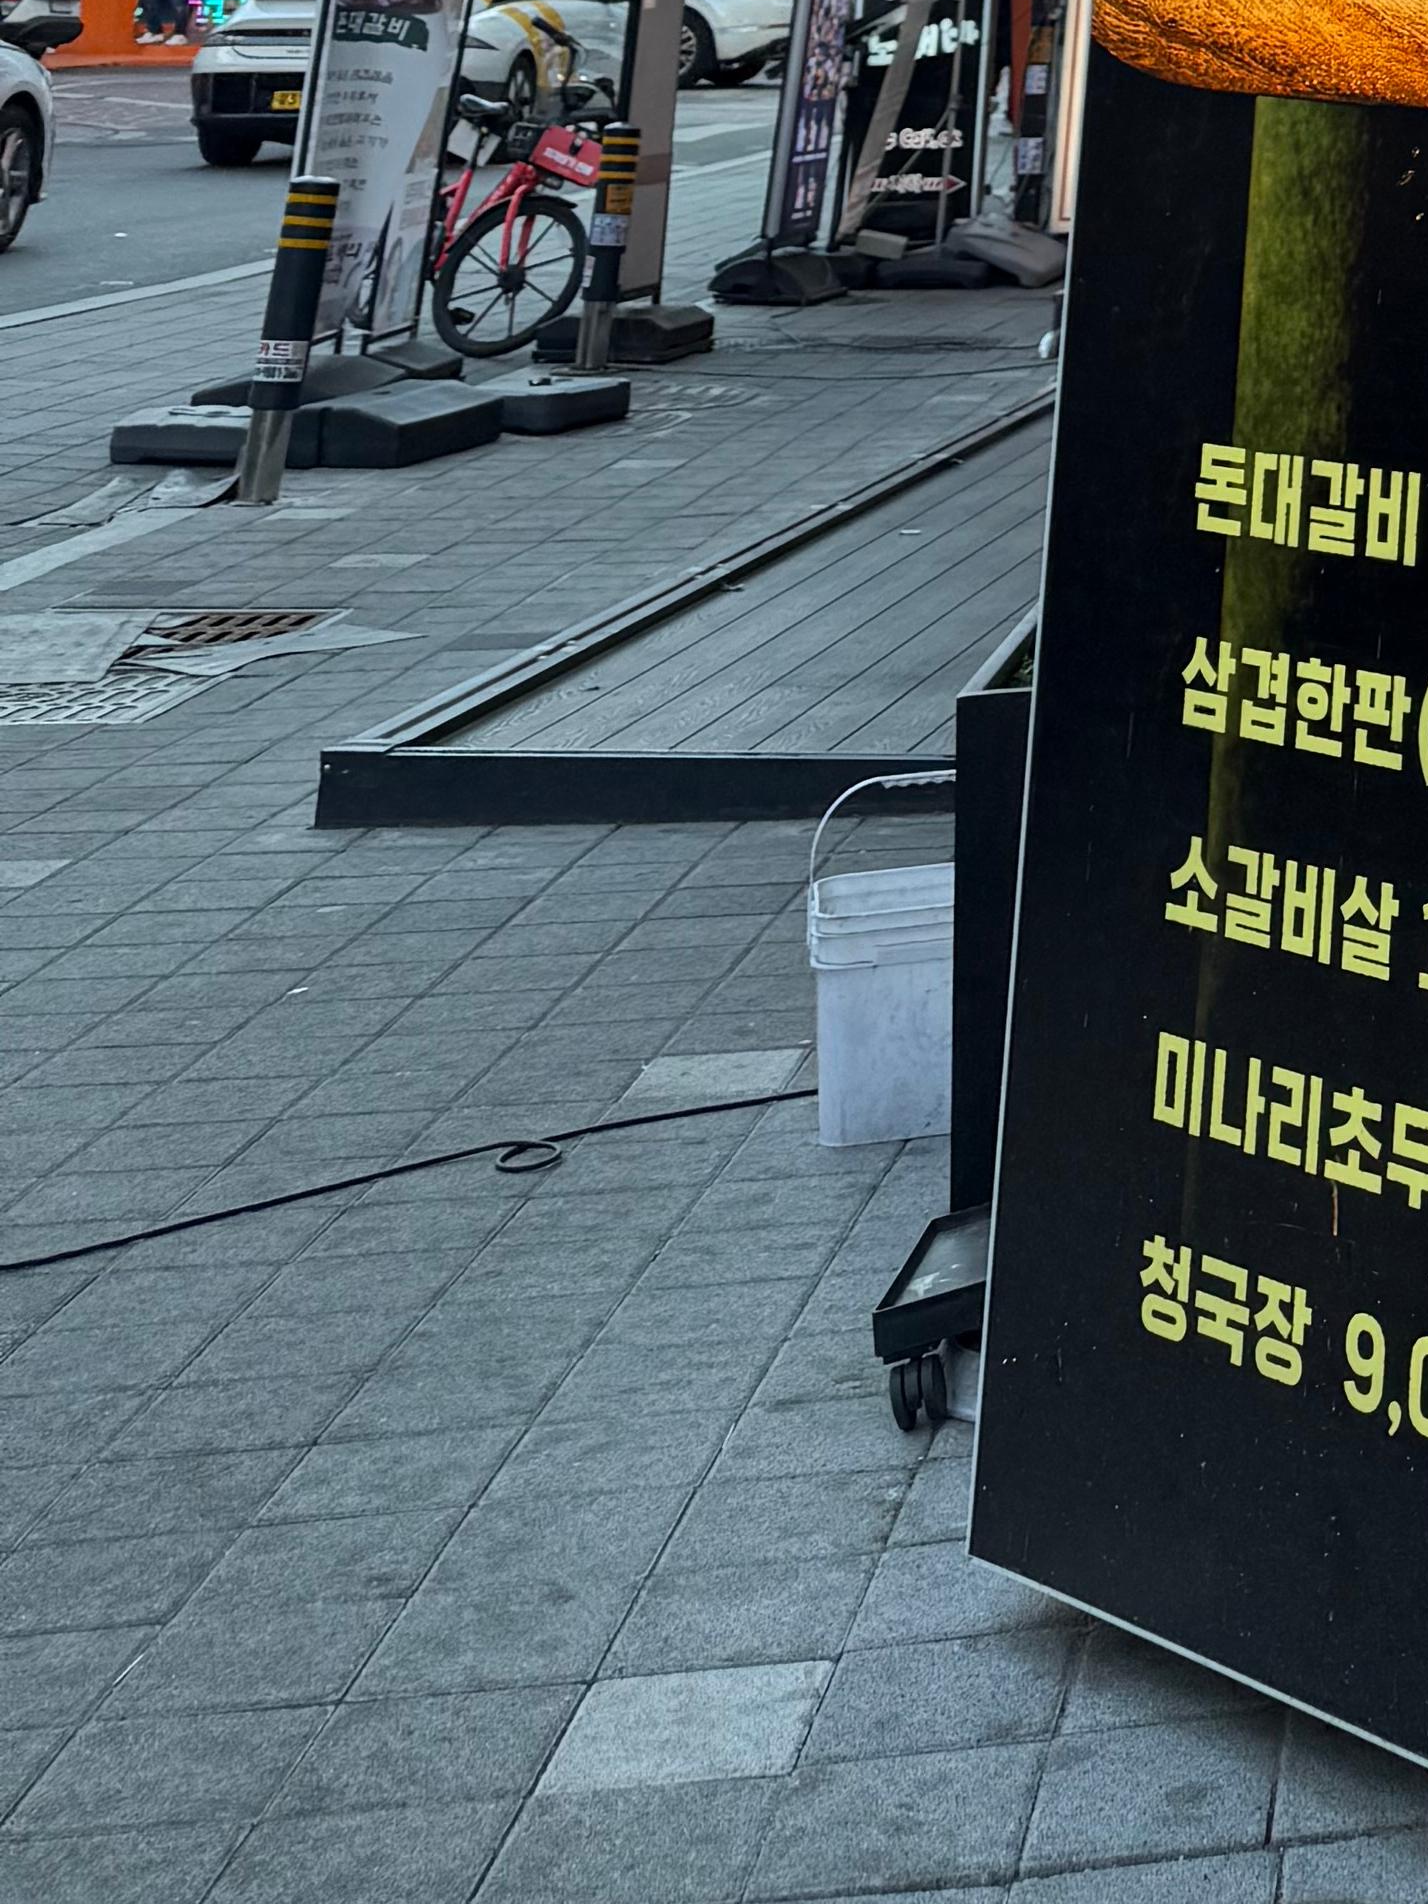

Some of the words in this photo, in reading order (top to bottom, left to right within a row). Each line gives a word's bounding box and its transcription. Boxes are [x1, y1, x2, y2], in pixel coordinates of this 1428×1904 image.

[1193, 440, 1419, 567] 돈대갈비
[1165, 834, 1400, 981] 소갈비살
[1140, 1233, 1310, 1388] 청국장
